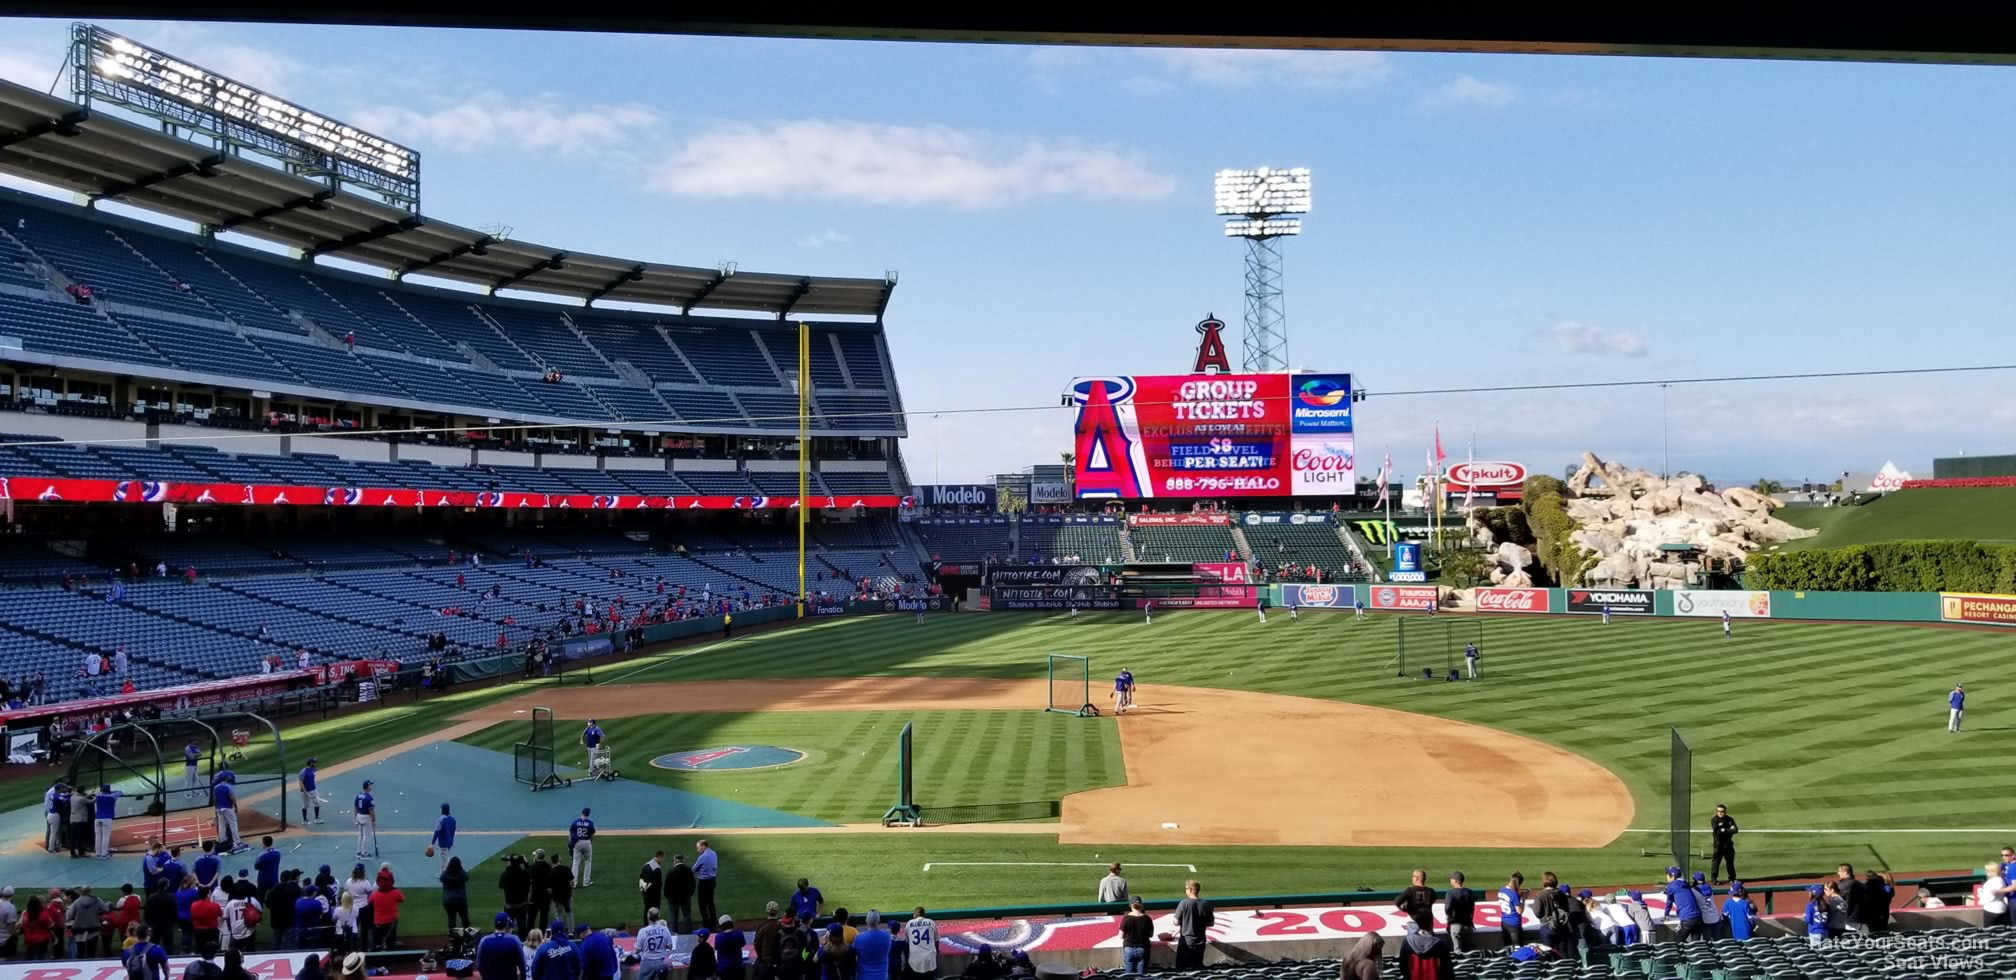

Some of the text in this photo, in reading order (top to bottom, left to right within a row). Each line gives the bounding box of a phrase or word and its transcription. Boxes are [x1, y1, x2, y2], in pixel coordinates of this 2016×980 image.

[1180, 381, 1257, 399] GROUP
[1172, 401, 1265, 419] TICKETS
[1295, 408, 1350, 418] Microsemi
[1210, 437, 1232, 454] $8
[1184, 457, 1216, 468] PER
[1218, 456, 1263, 468] SEAT!
[1292, 449, 1353, 471] Coors
[1304, 472, 1345, 482] LIGHT
[1462, 469, 1513, 479] Yakult
[1872, 473, 1906, 488] Coo
[1166, 477, 1280, 490] 888-796-HALO
[933, 485, 986, 504] Modelo
[1036, 486, 1068, 498] Modelo
[1223, 566, 1244, 581] LA
[1477, 590, 1535, 609] Coca-Cola
[1589, 592, 1650, 604] YOKOHAMA
[817, 605, 844, 614] Fanatics
[1964, 602, 2016, 612] PECHANGA
[576, 827, 589, 838] 82
[647, 936, 664, 951] 67
[911, 928, 930, 945] 34
